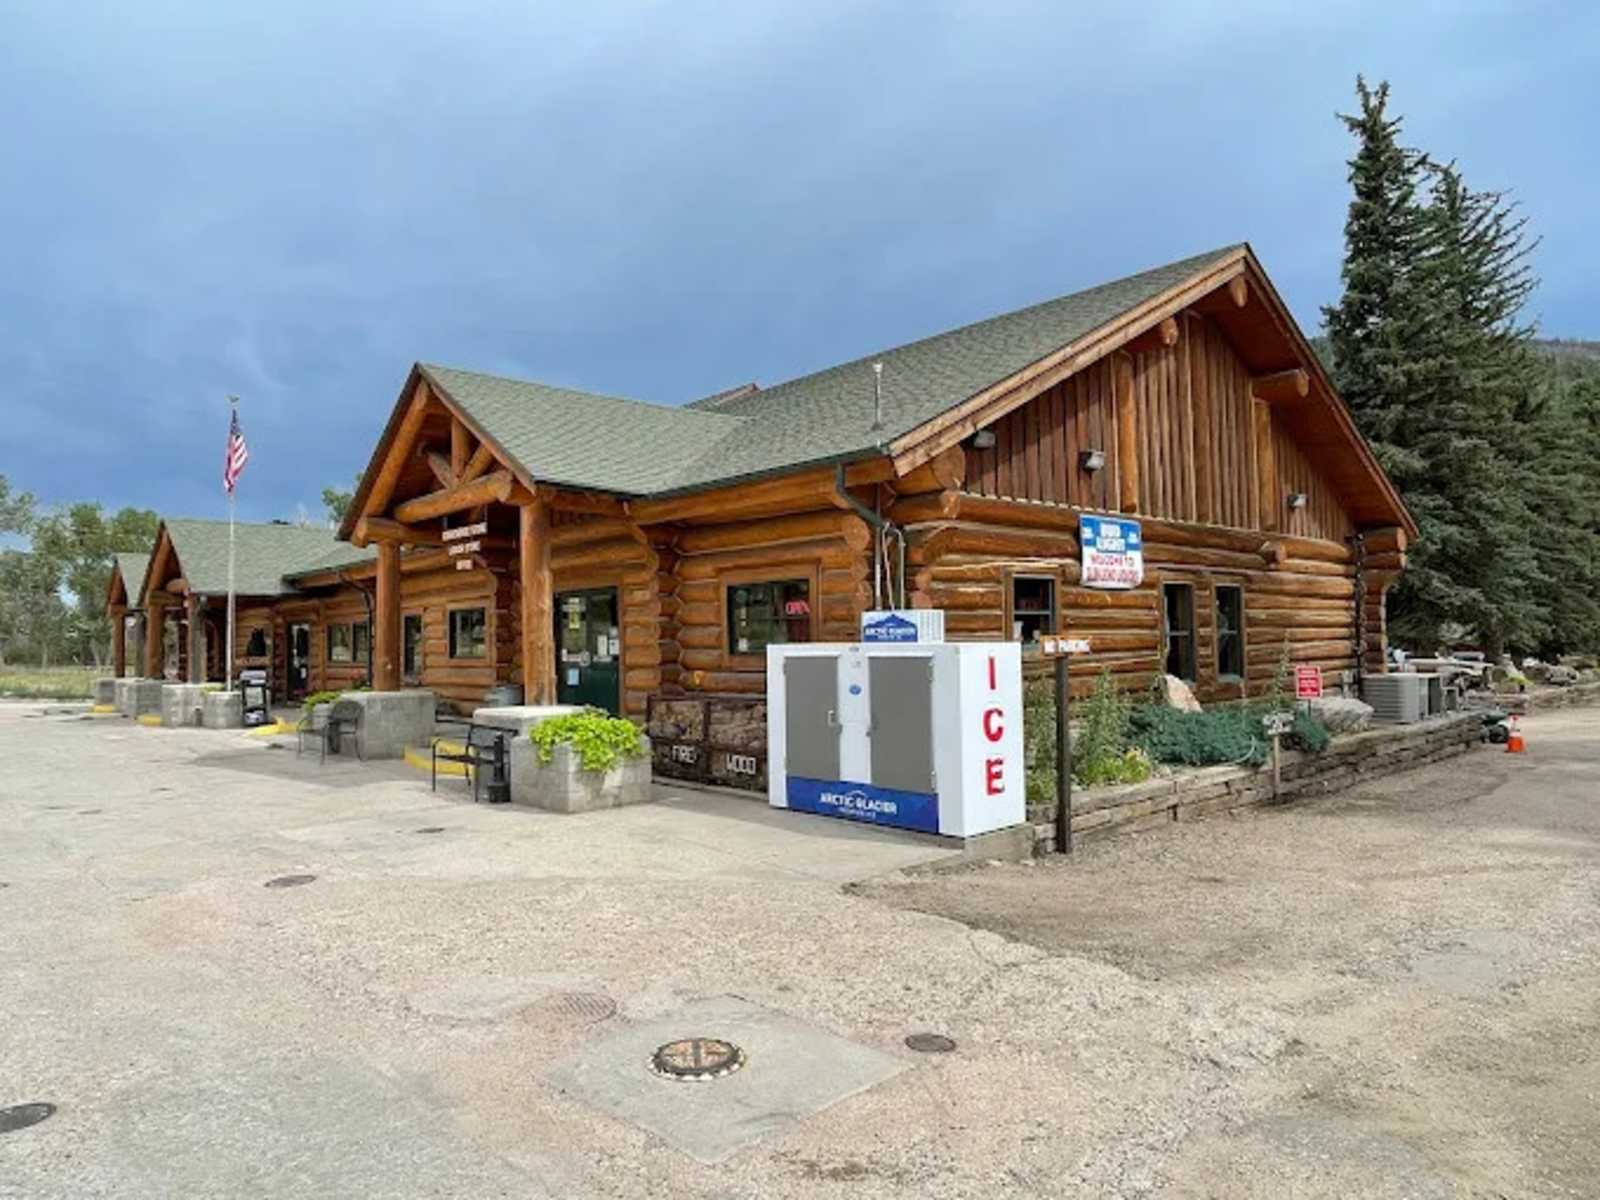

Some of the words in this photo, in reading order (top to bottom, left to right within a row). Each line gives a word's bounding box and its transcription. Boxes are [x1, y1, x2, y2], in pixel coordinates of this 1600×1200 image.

[982, 655, 1005, 796] ICE
[672, 744, 698, 764] FIRE
[726, 754, 757, 775] WOOD
[820, 792, 855, 807] ARCTIC
[856, 798, 897, 815] GLACIER
